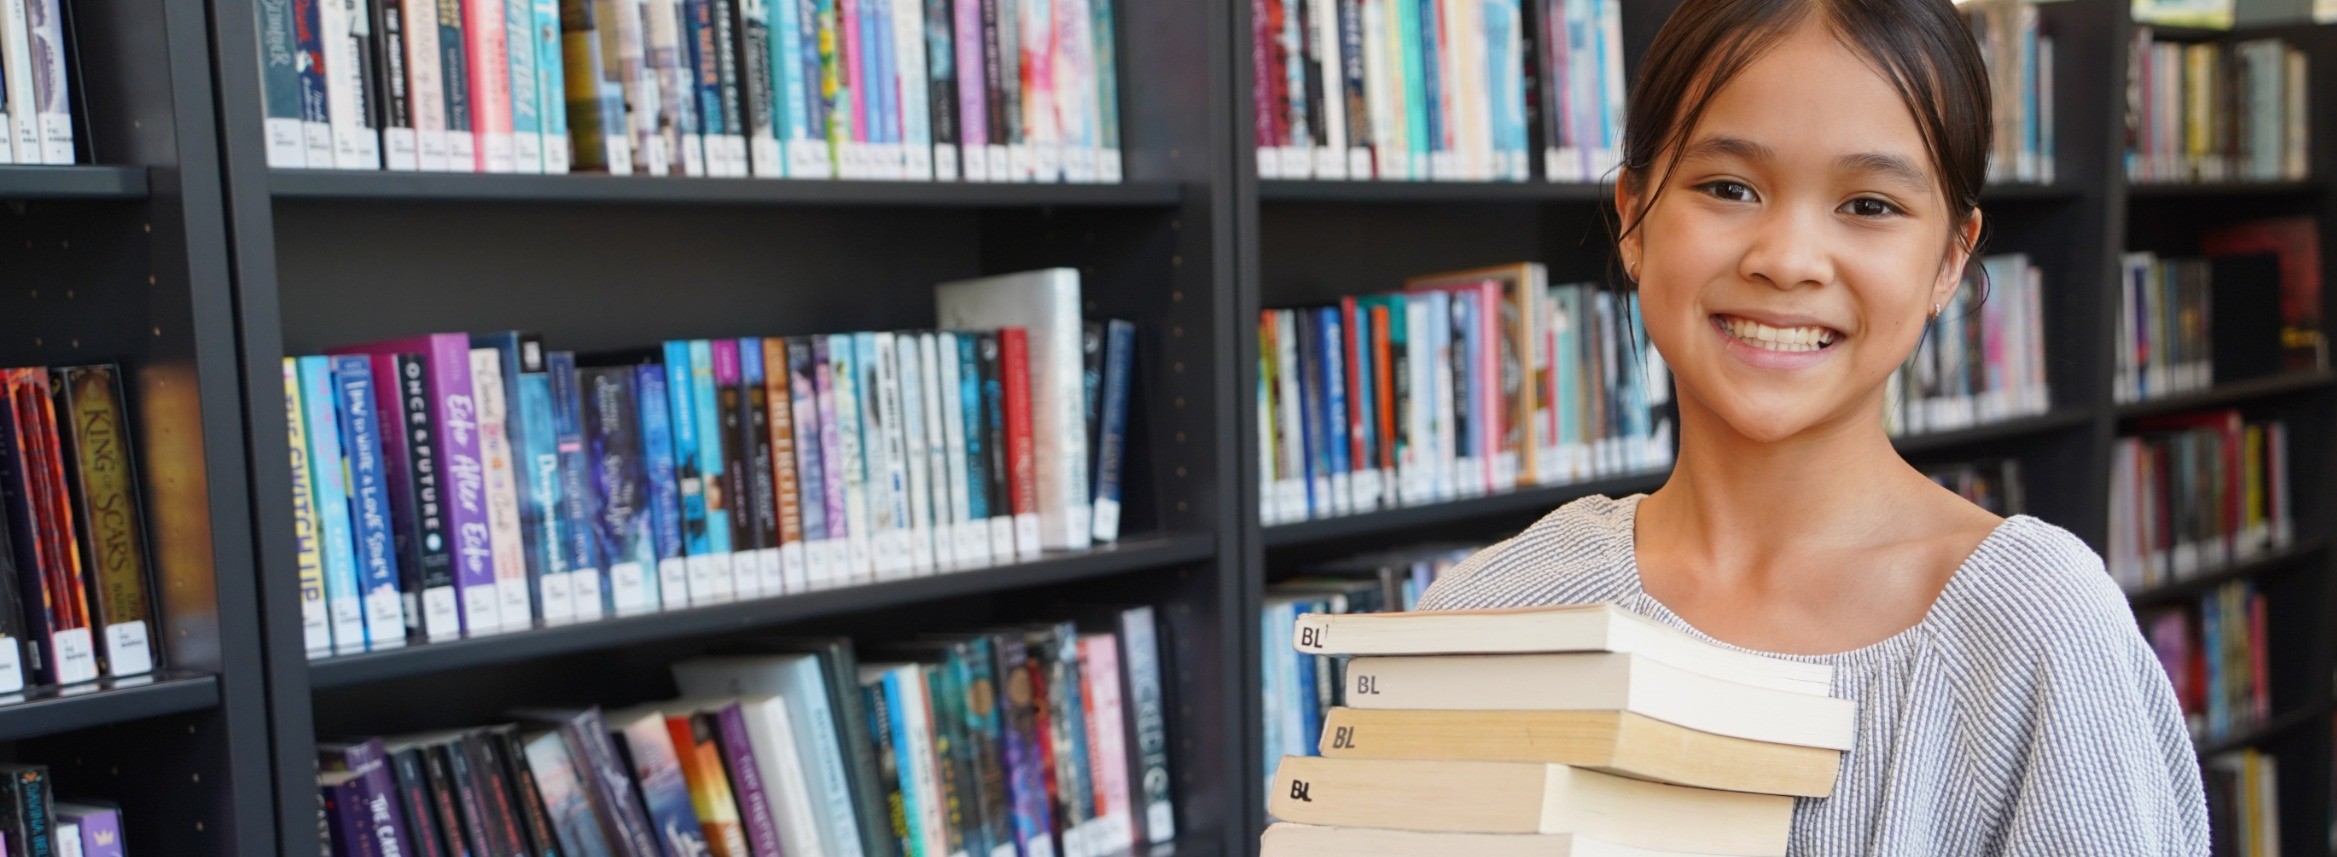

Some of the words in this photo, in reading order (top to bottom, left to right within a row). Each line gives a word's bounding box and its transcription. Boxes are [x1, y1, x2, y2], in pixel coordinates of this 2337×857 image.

[84, 407, 115, 472] KING
[406, 361, 427, 424] ONCE
[417, 445, 440, 530] FUTURE
[446, 394, 475, 447] Echo
[360, 486, 384, 530] LOVE
[452, 453, 482, 515] After
[94, 492, 131, 572] SCARS
[365, 531, 389, 579] STORY
[460, 522, 490, 575] Echo
[1301, 627, 1323, 648] BL
[1357, 675, 1380, 694] BL
[1332, 726, 1355, 749] BL
[1290, 779, 1312, 802] BL
